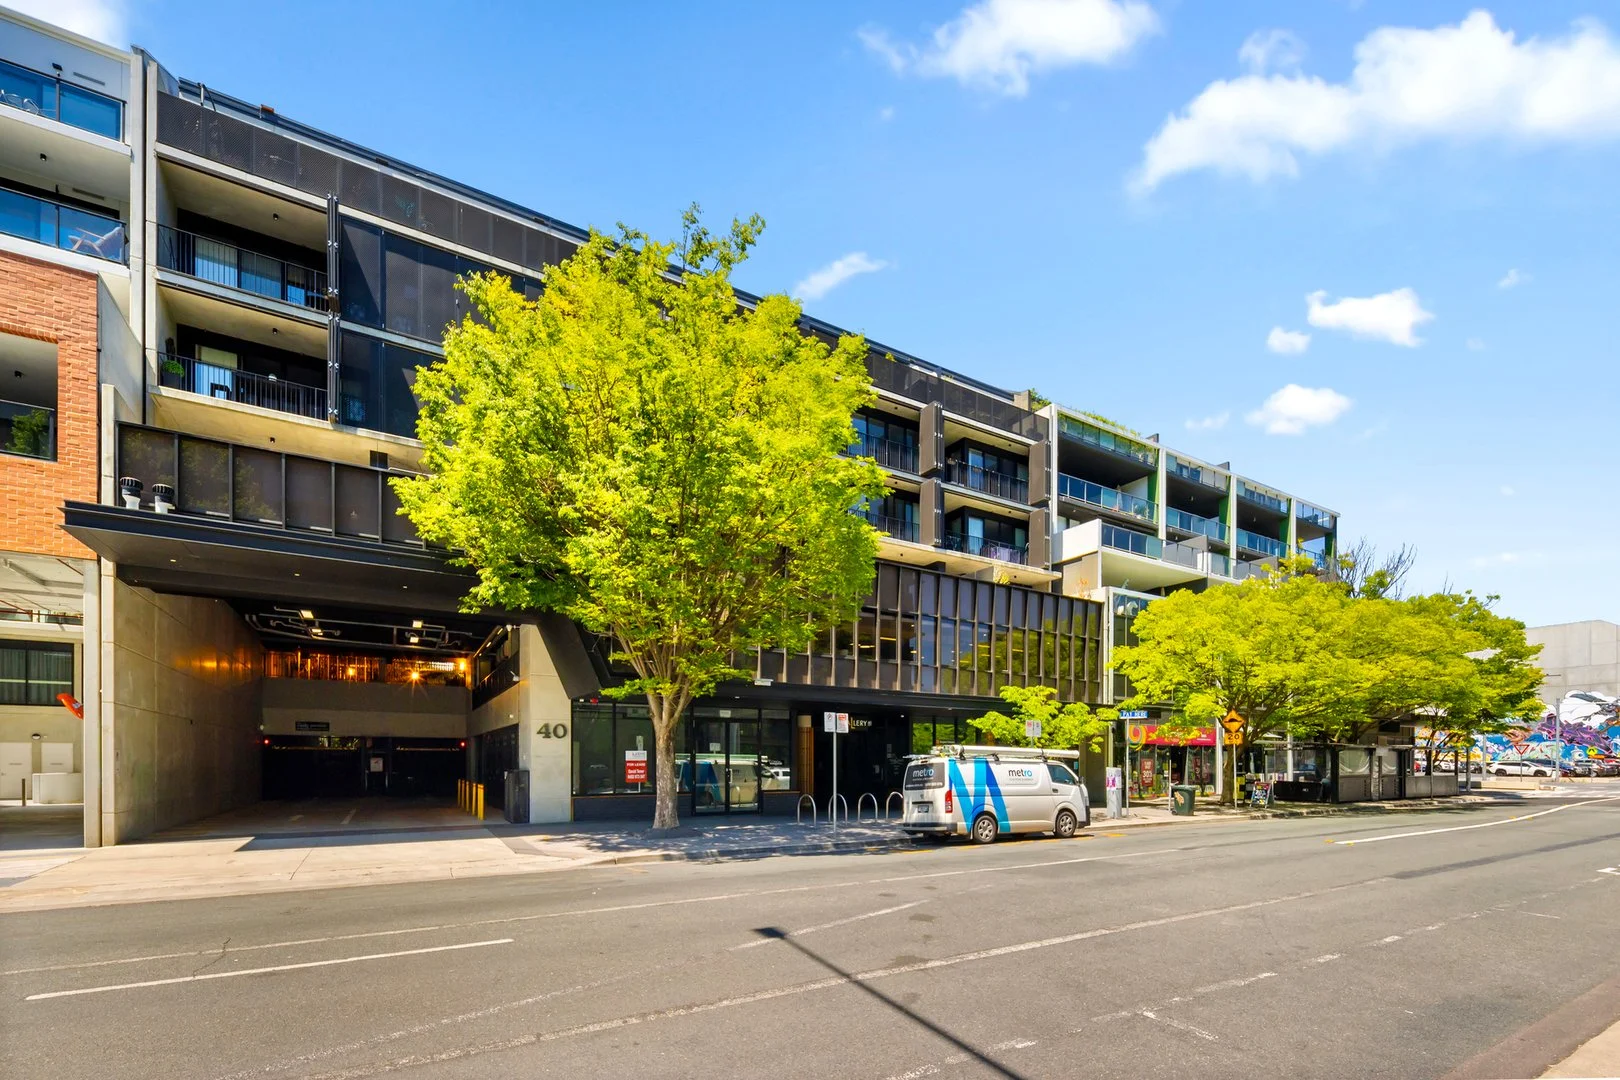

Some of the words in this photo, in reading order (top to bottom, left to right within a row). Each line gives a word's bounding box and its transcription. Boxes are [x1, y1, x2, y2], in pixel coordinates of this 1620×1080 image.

[536, 723, 568, 739] 40
[1228, 733, 1240, 741] 20
[912, 768, 935, 777] metro
[1008, 768, 1033, 777] metro
